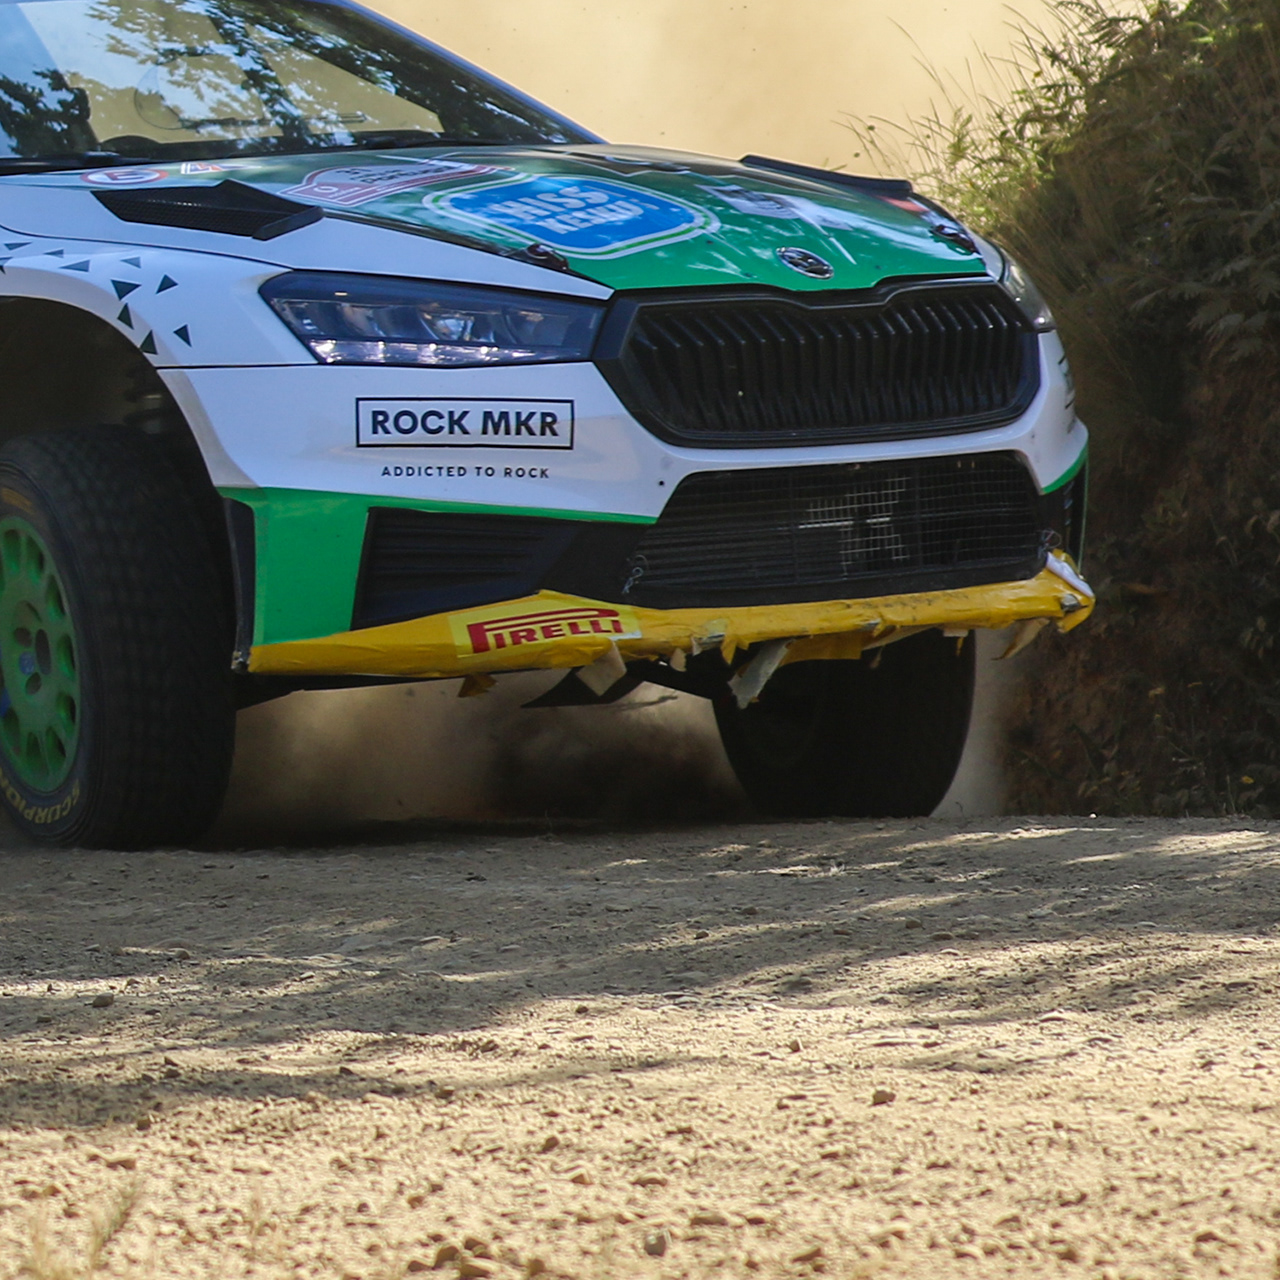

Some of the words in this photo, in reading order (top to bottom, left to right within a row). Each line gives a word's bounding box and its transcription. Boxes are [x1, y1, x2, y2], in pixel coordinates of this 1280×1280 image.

[371, 410, 470, 435] ROCK
[481, 410, 559, 437] MKR
[381, 466, 467, 477] ADDICTED
[475, 466, 495, 477] TO
[504, 467, 549, 479] ROCK
[467, 608, 623, 654] PIRELLI
